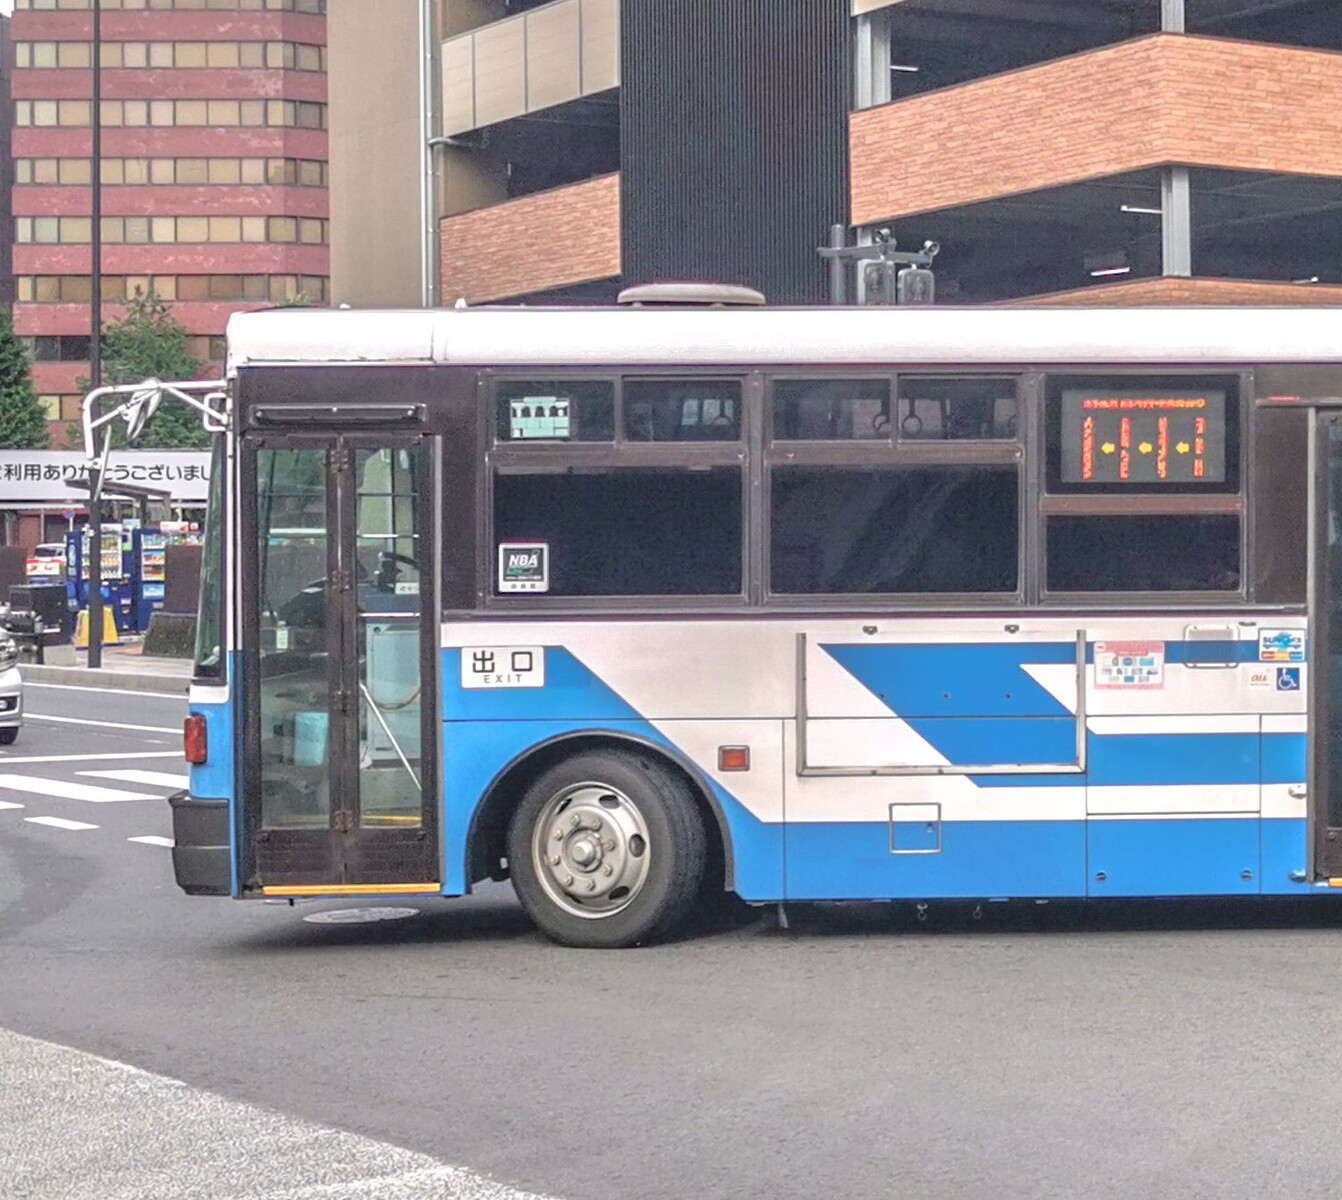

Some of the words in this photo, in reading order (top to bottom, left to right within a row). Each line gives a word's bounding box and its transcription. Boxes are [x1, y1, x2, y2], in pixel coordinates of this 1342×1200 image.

[0, 463, 210, 482] 利用ありうございまし
[509, 554, 538, 568] NBA
[472, 650, 533, 673] 出口
[483, 674, 523, 684] EXIT
